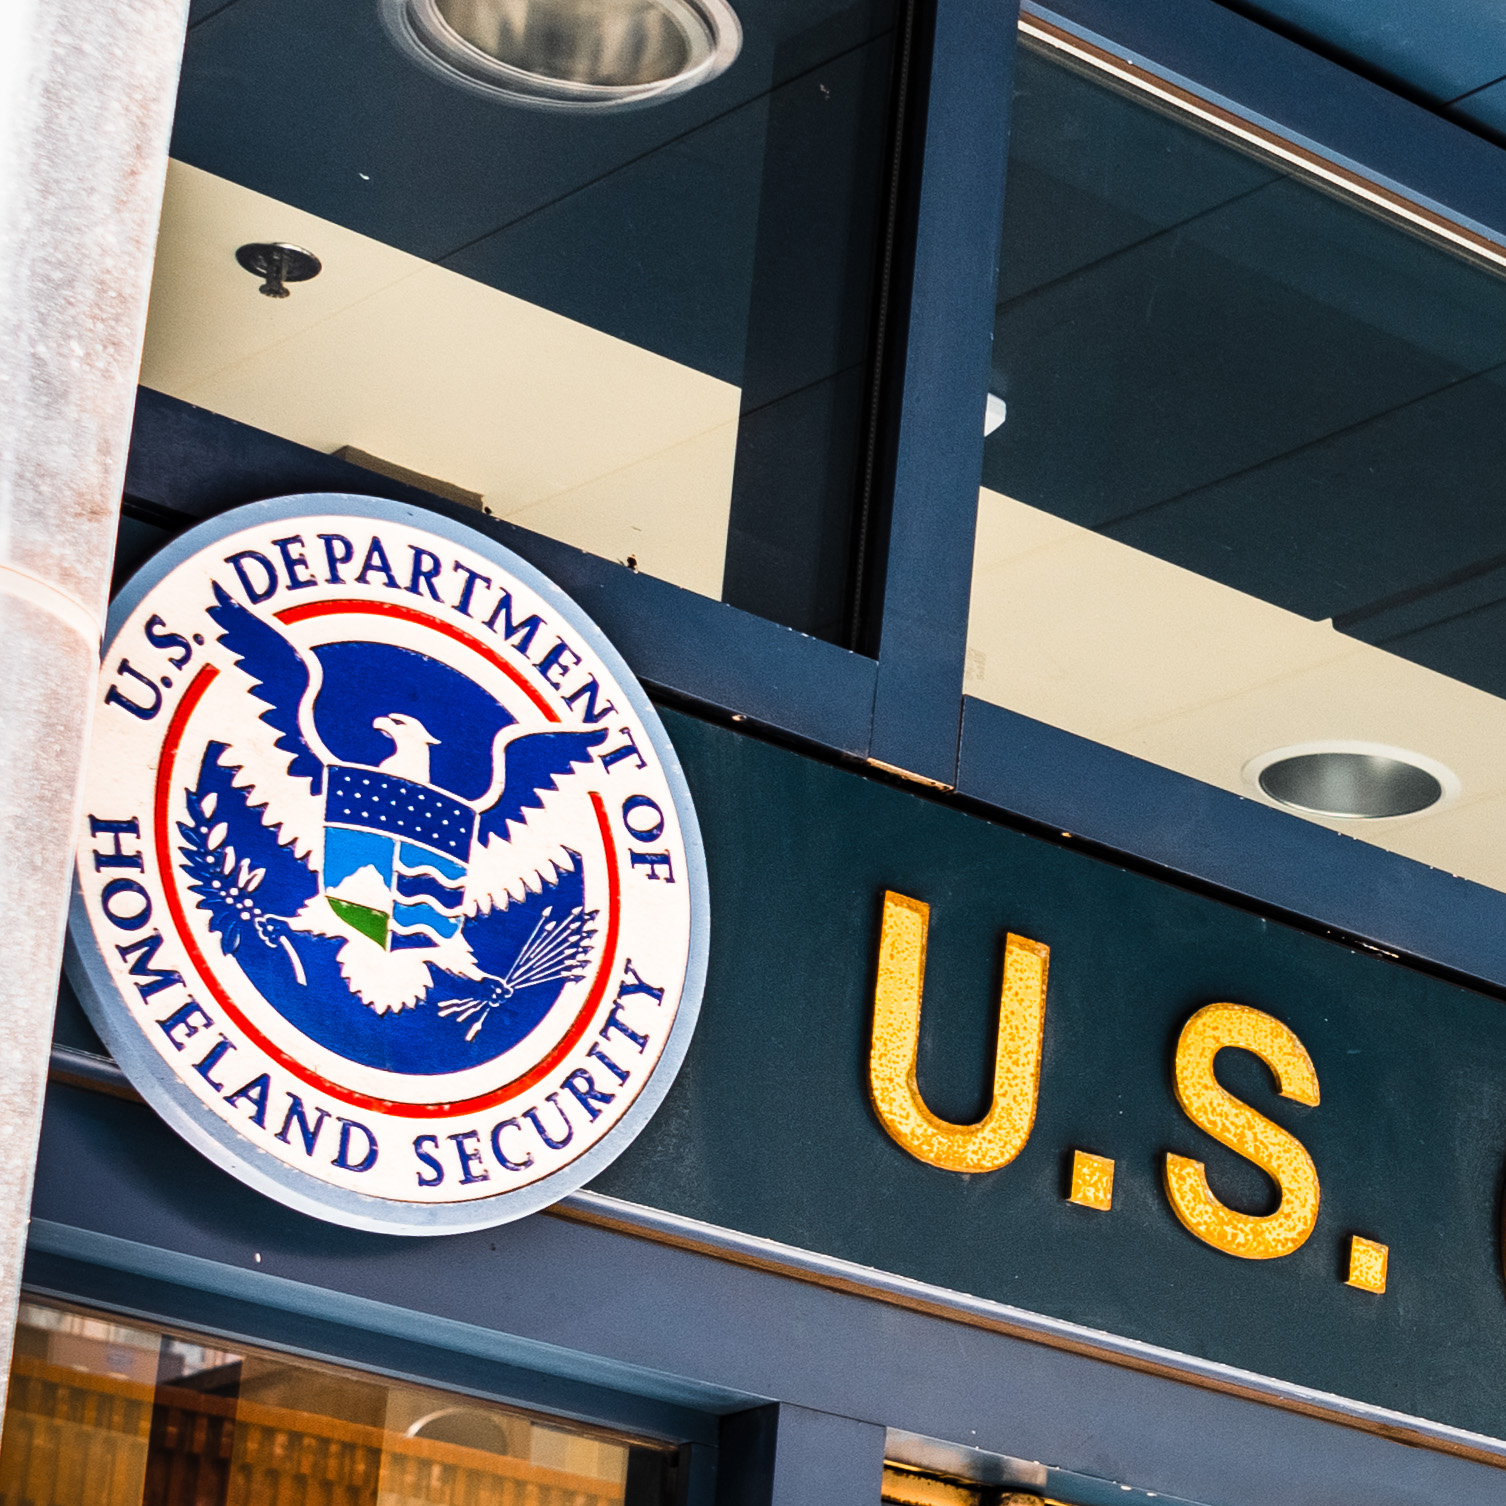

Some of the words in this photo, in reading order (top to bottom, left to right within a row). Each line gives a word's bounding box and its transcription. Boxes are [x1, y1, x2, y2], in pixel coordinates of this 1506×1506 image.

[104, 614, 206, 720] U.S.
[224, 533, 646, 778] DEPARTMENT
[624, 794, 675, 885] OF
[88, 814, 379, 1174] HOMELAND
[415, 959, 665, 1188] SECURITY
[868, 889, 1389, 1295] U.S.
